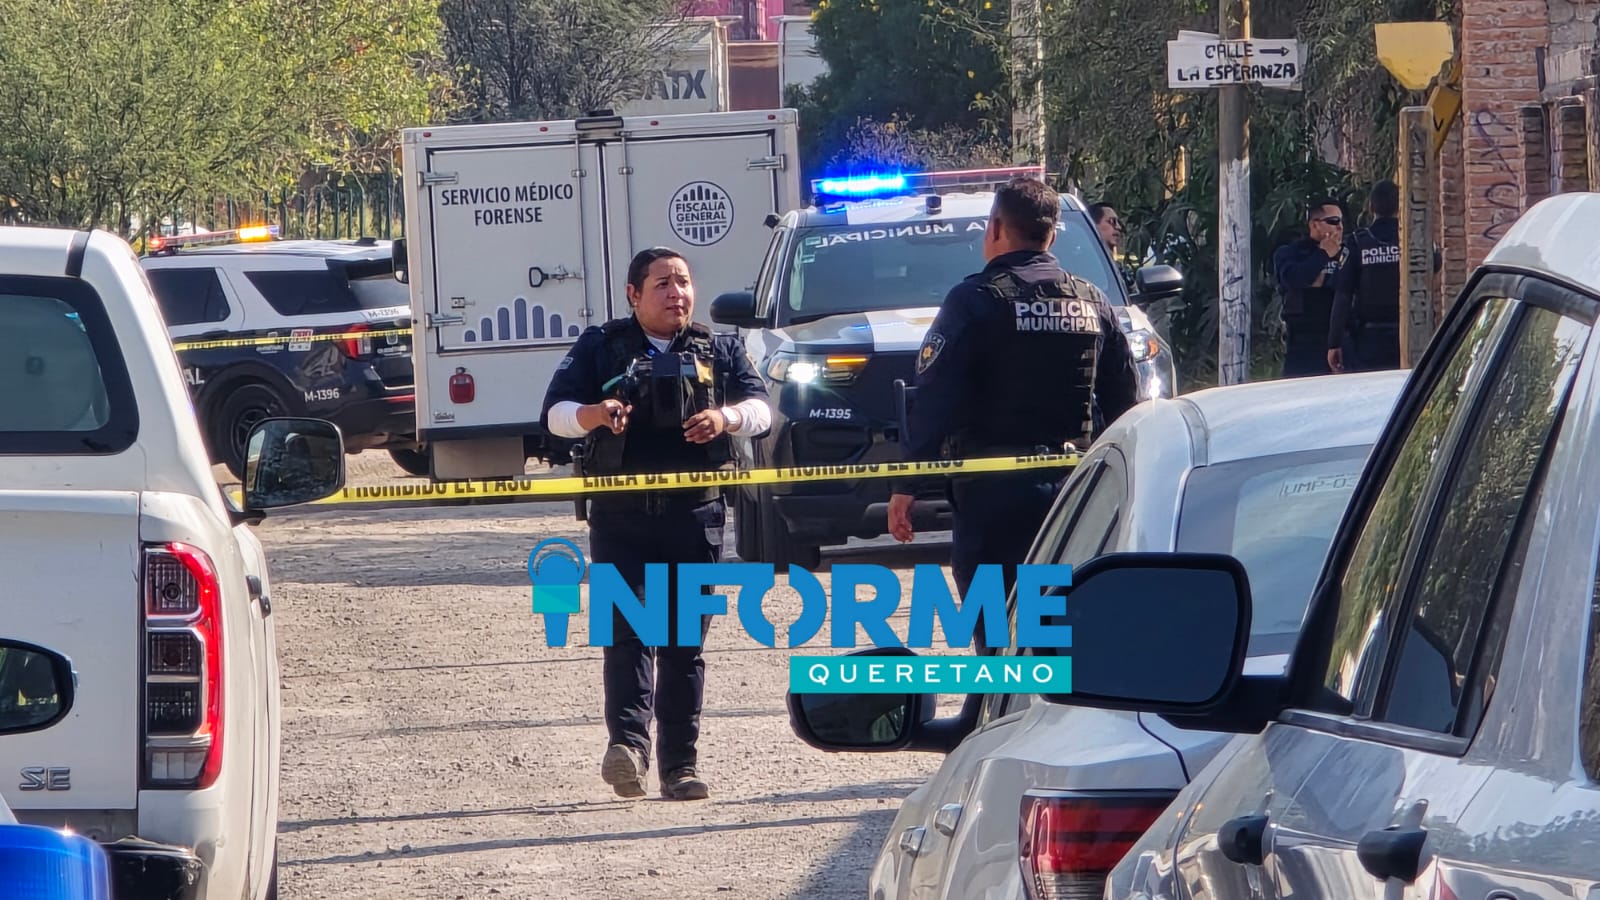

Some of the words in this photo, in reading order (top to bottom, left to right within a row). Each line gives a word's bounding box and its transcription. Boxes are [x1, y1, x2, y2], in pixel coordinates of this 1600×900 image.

[1205, 43, 1254, 59] CALLE
[1205, 63, 1296, 80] ESPERANZA
[441, 186, 510, 206] SERVICIO
[515, 181, 573, 203] MÉDICO
[474, 206, 543, 226] FORENSE
[676, 211, 727, 222] GENERAL
[1361, 246, 1399, 256] POLIC
[1016, 316, 1101, 333] MUNICIPAL
[304, 387, 340, 403] M-1396
[809, 408, 852, 420] M-1395
[19, 766, 71, 791] SE
